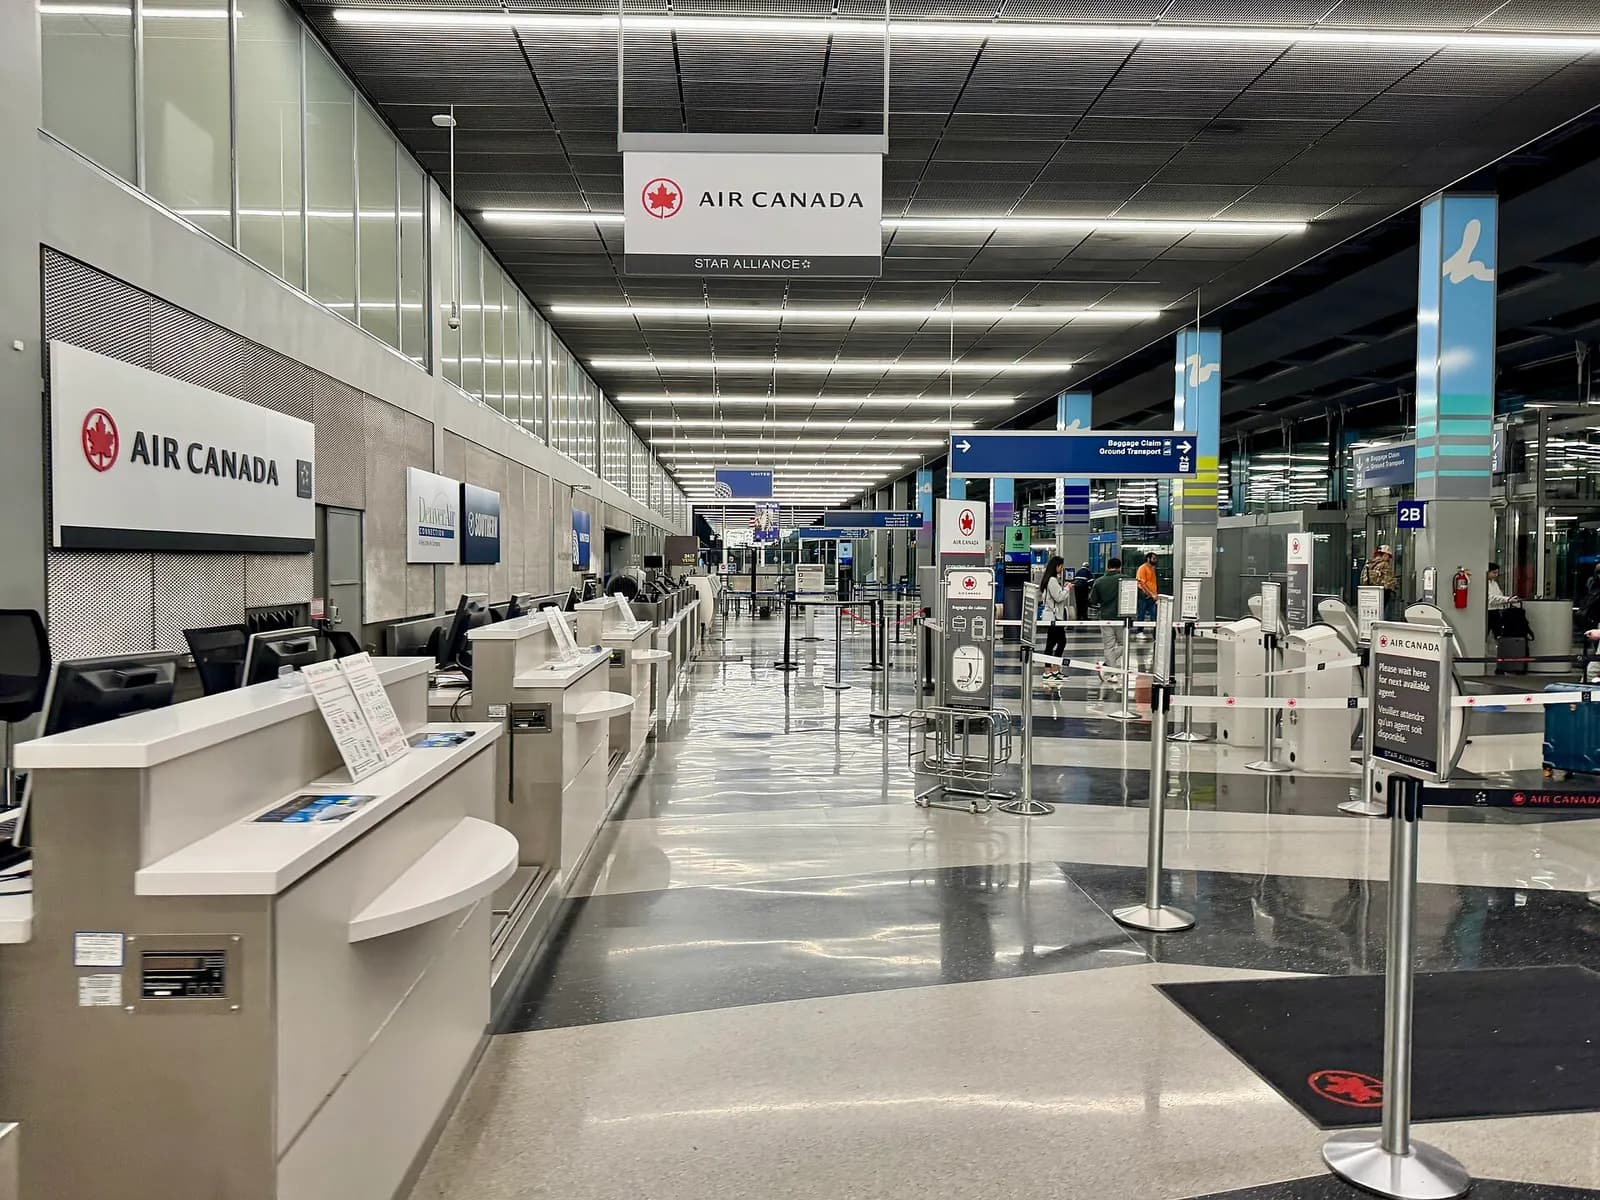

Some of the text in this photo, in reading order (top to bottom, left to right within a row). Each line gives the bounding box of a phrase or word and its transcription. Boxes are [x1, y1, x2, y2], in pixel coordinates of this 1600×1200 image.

[699, 191, 864, 208] AIR CANADA
[694, 258, 801, 269] STAR ALLIANCE
[130, 430, 279, 487] AIR CANADA
[1127, 448, 1161, 456] Transport
[1400, 508, 1421, 521] 2B
[1390, 639, 1440, 652] AIR CANADA
[1379, 662, 1427, 678] Please wait here
[1379, 674, 1430, 692] for next available
[1394, 722, 1410, 732] agent
[1530, 795, 1550, 804] AIR
